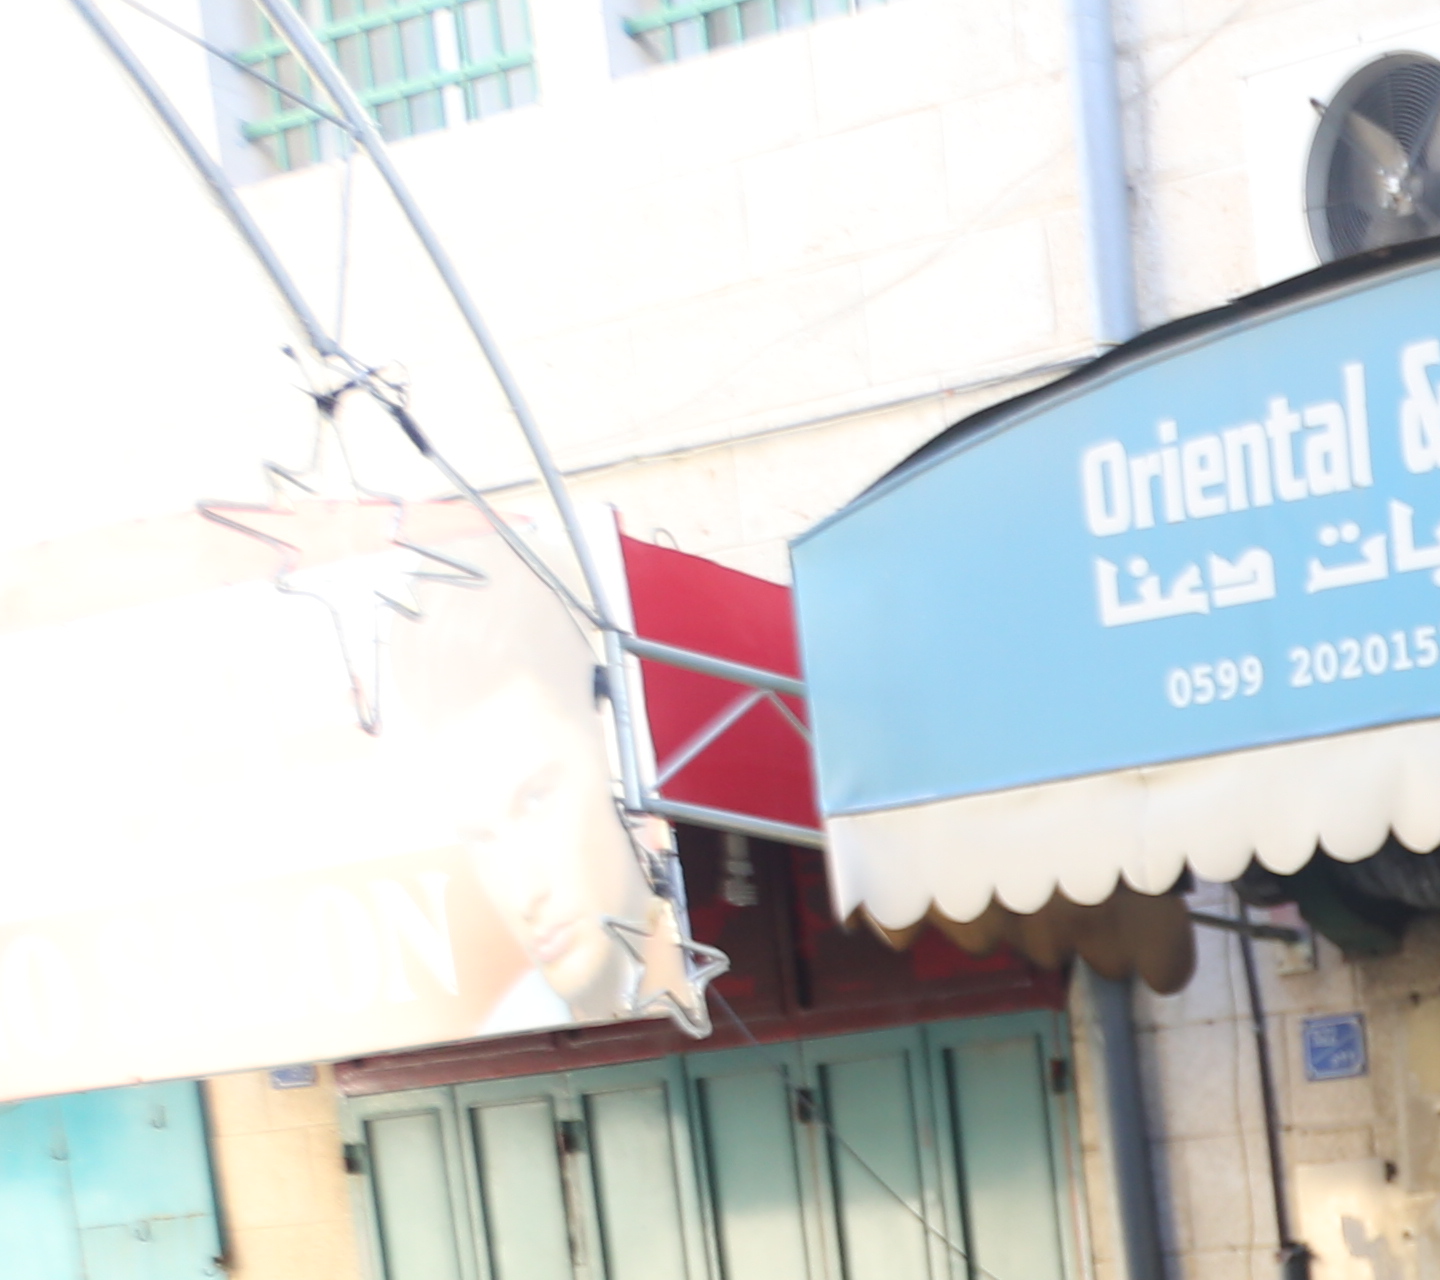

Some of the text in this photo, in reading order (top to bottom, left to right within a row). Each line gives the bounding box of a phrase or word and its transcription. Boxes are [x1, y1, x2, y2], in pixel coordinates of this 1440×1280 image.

[1080, 360, 1374, 538] Oriental
[1166, 654, 1264, 709] 0599
[1287, 624, 1438, 688] 202015
